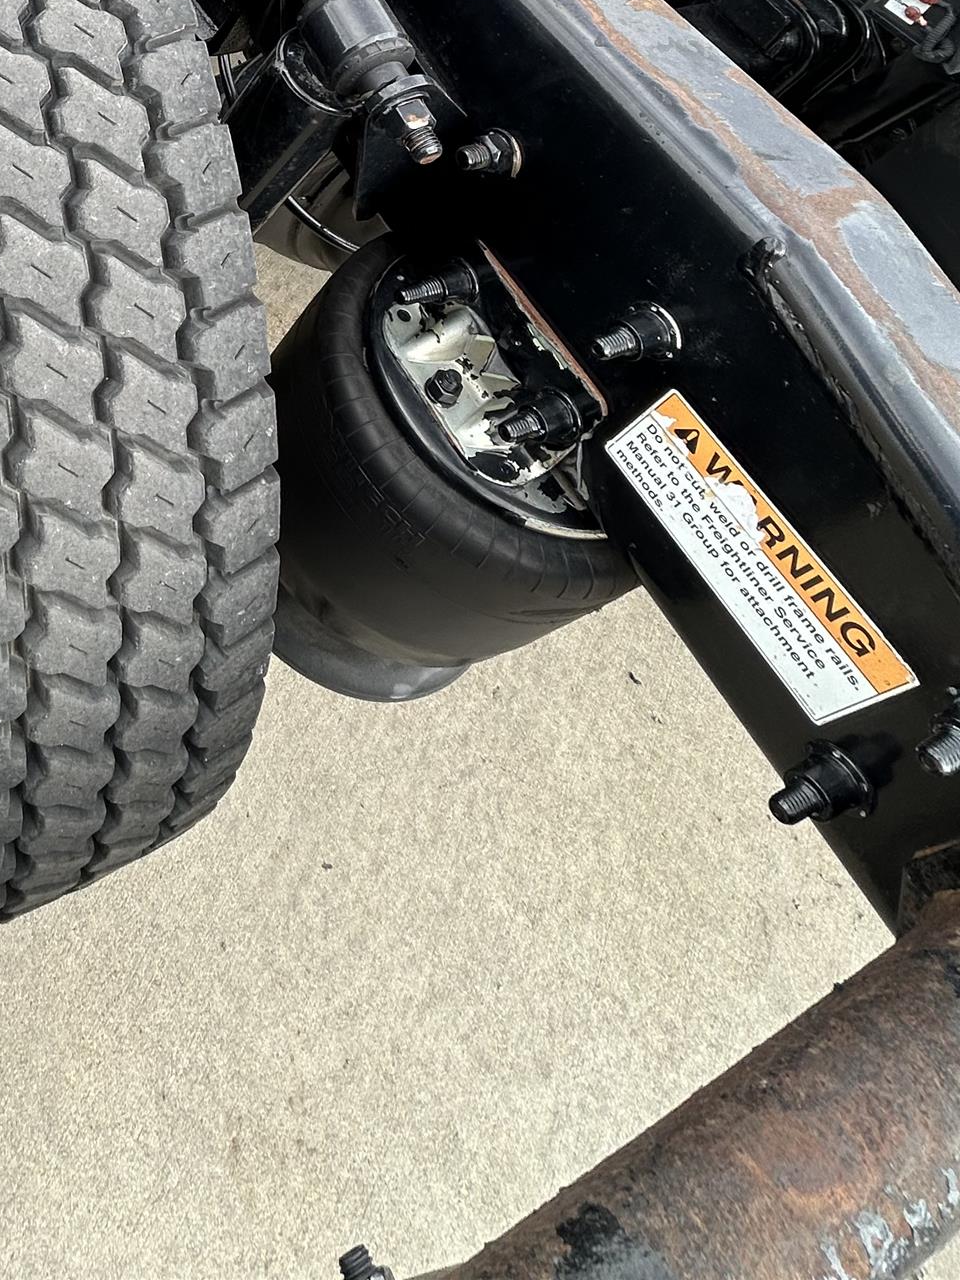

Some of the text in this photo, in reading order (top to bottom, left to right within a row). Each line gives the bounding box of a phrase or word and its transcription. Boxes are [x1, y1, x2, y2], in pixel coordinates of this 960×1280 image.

[616, 449, 664, 512] methods.
[626, 440, 667, 490] Manual
[665, 491, 682, 508] 31
[682, 512, 720, 558] Group
[720, 561, 741, 583] for
[739, 587, 815, 679] attachment
[636, 432, 668, 468] Refer
[667, 471, 680, 487] to
[680, 488, 701, 513] the
[701, 514, 774, 602] Freightliner
[773, 606, 826, 670] Service
[646, 423, 859, 691] Do not cut, weld or drill frame rails.
[705, 451, 876, 658] WRNING
